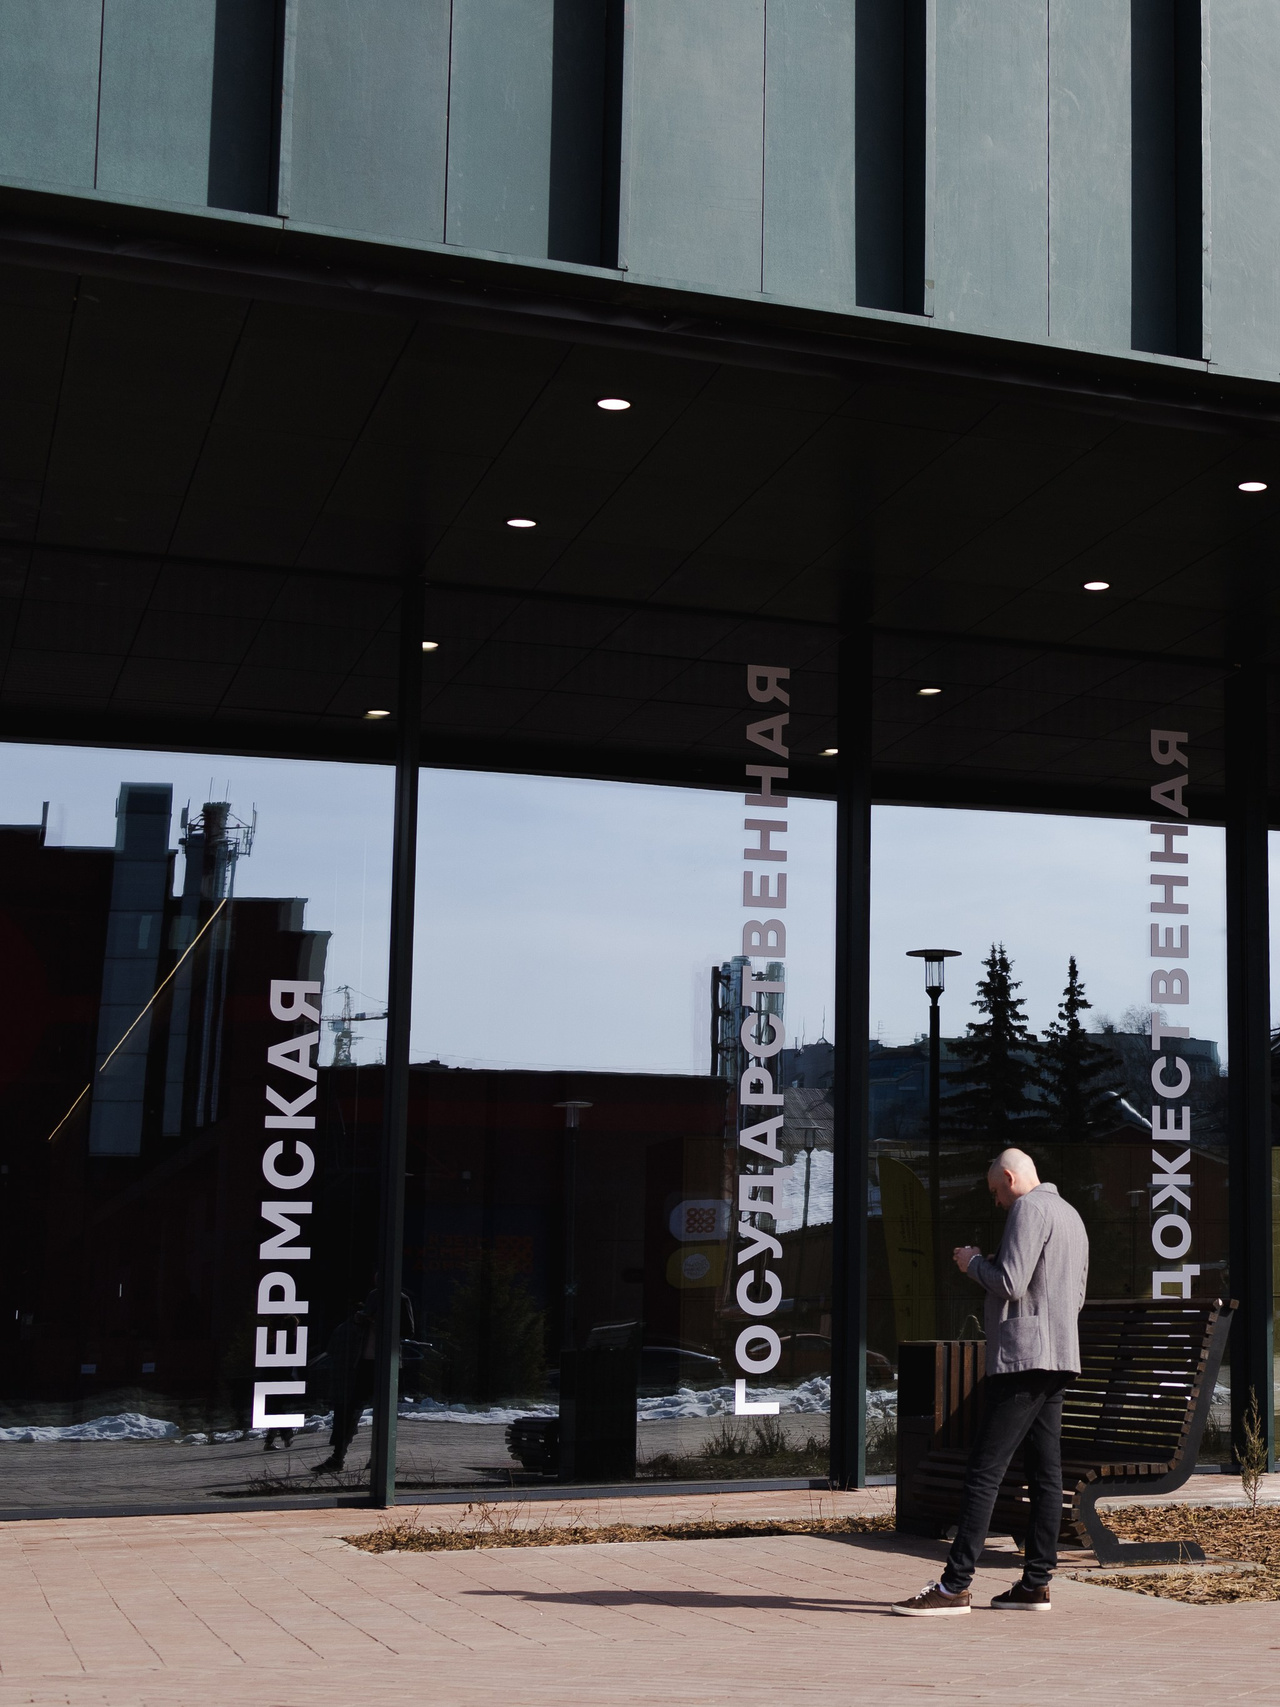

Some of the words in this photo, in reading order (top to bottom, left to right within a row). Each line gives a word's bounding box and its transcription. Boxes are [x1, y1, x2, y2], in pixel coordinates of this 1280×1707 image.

[252, 979, 323, 1429] ПЕРМСКАЯ
[735, 664, 793, 1416] ГОСУДАРСТВЕННАЯ
[1150, 729, 1200, 1399] ДОЖЕСТВЕННАЯ
